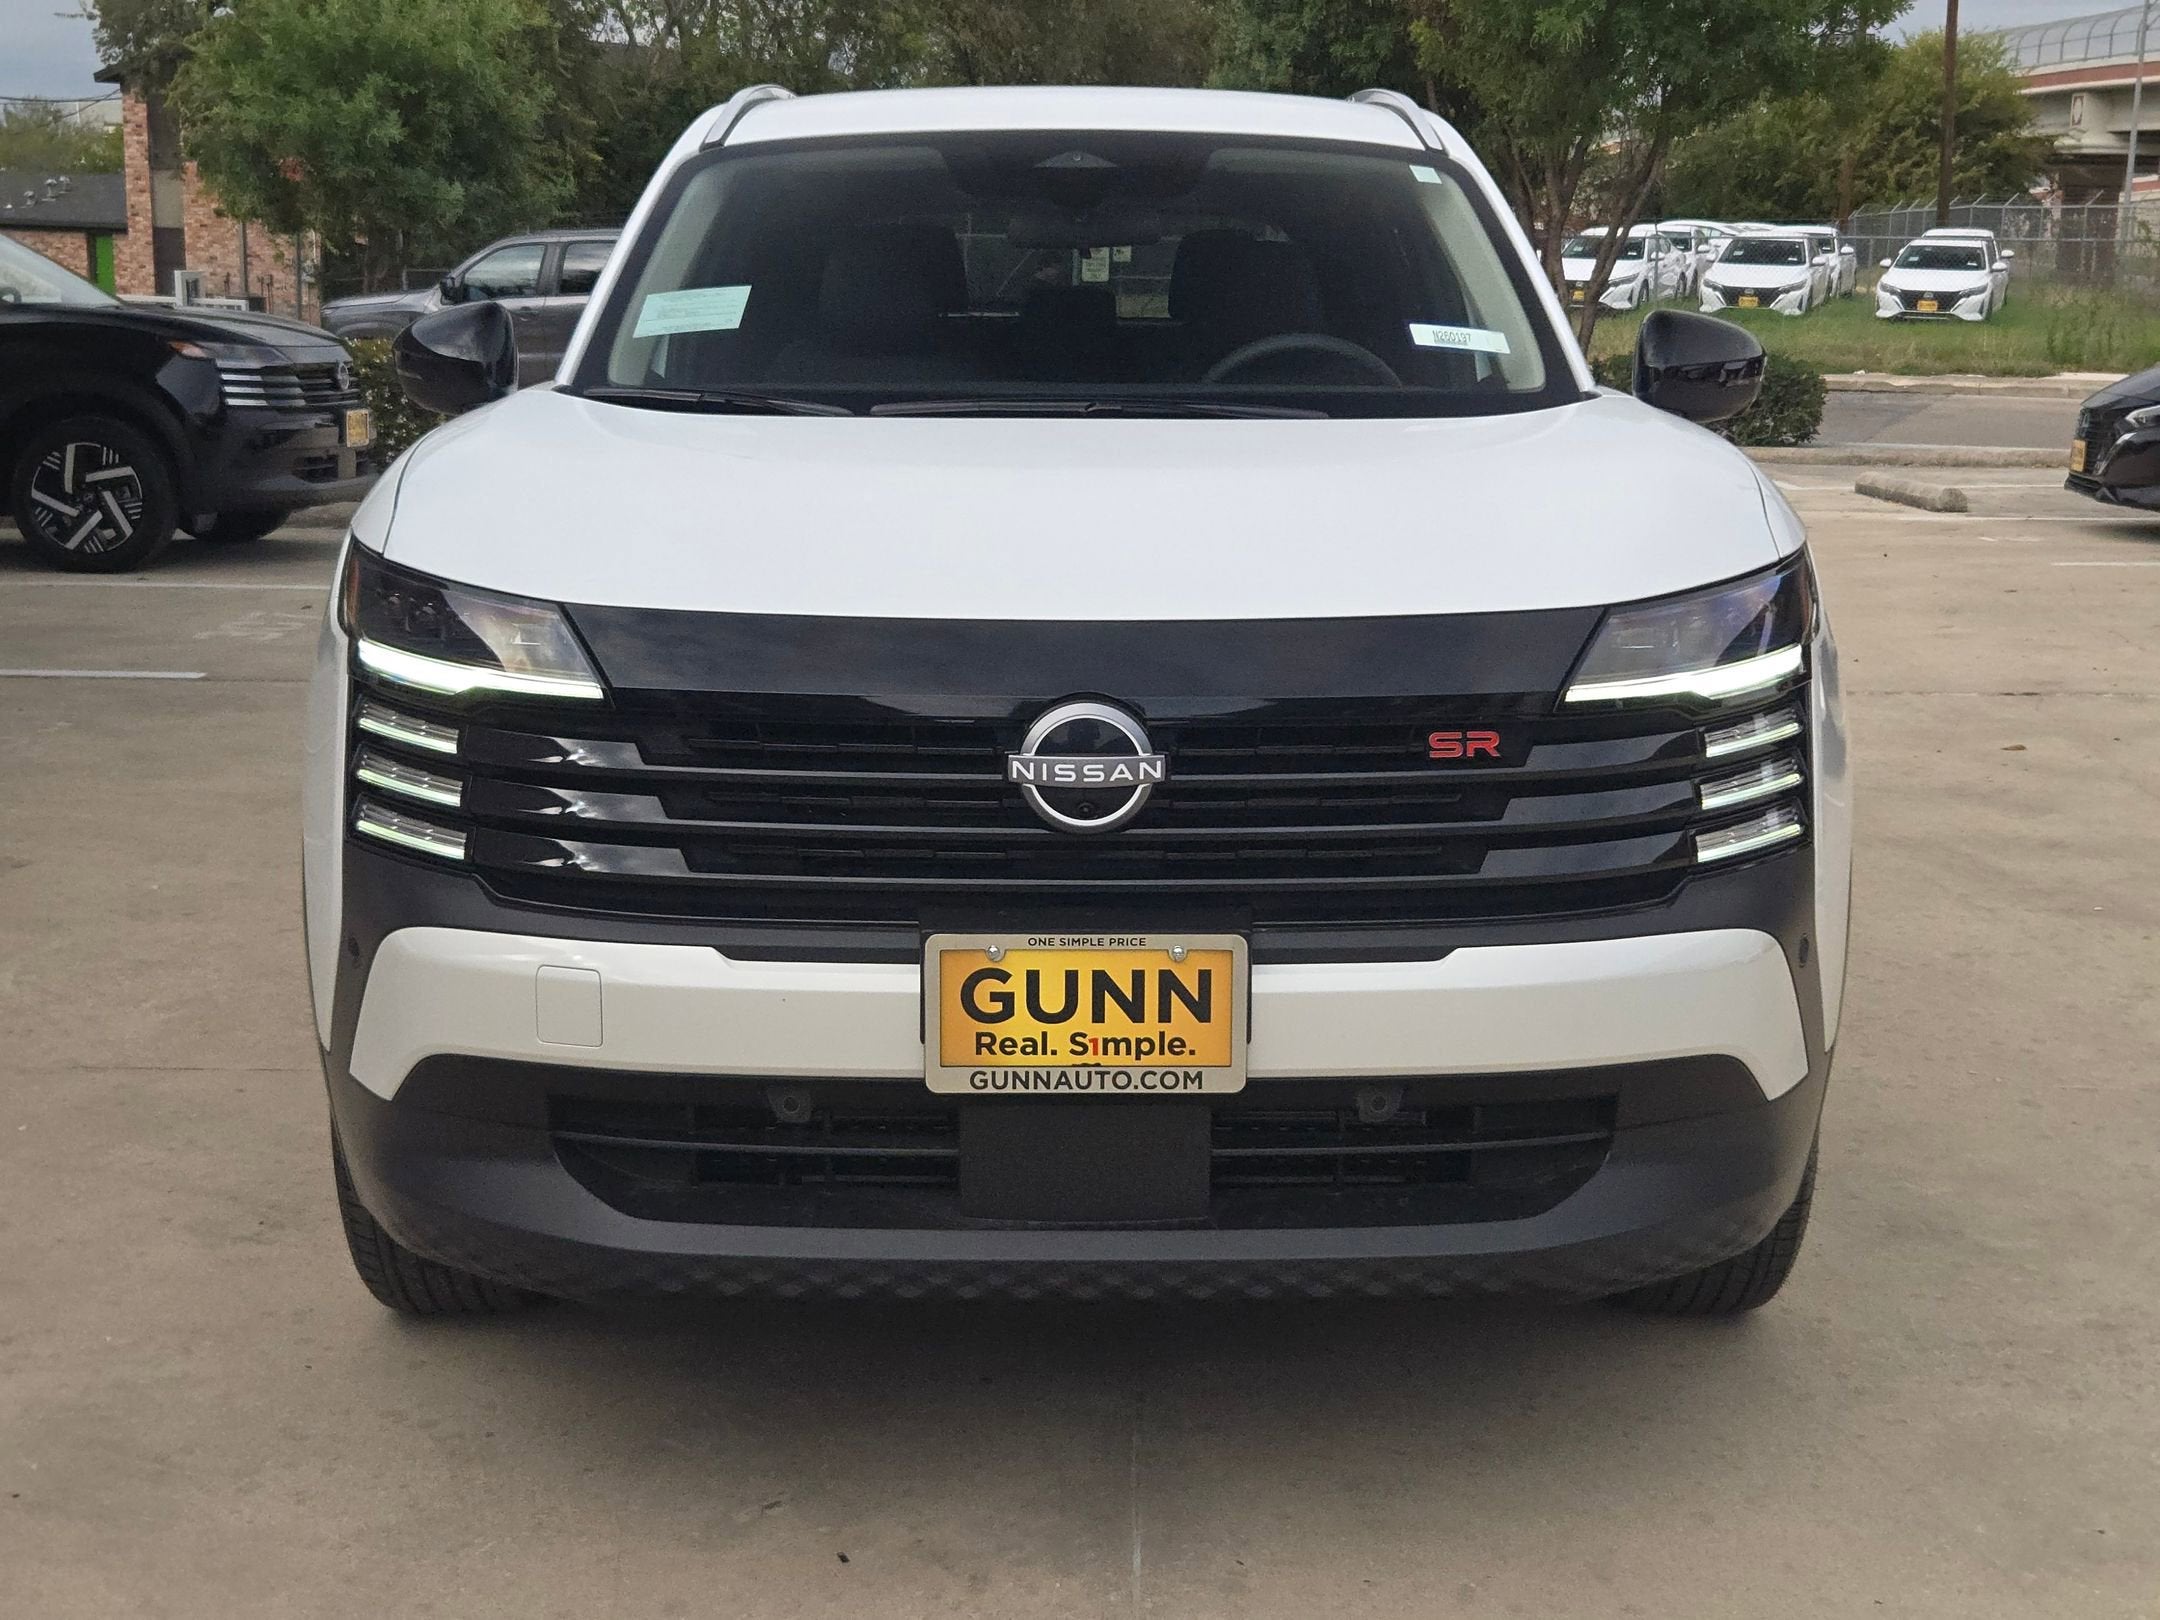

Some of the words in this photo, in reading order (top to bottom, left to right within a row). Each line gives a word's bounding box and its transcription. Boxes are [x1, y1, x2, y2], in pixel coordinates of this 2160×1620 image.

[1428, 730, 1501, 758] SR
[1011, 760, 1162, 782] NISSAN
[1027, 937, 1055, 947] ONE
[1059, 937, 1105, 947] SIMPLE
[1109, 937, 1147, 947] PRICE
[960, 967, 1213, 1025] GUNN
[975, 1031, 1058, 1056] Real.
[969, 1070, 1203, 1090] GUNNAUTO.COM
